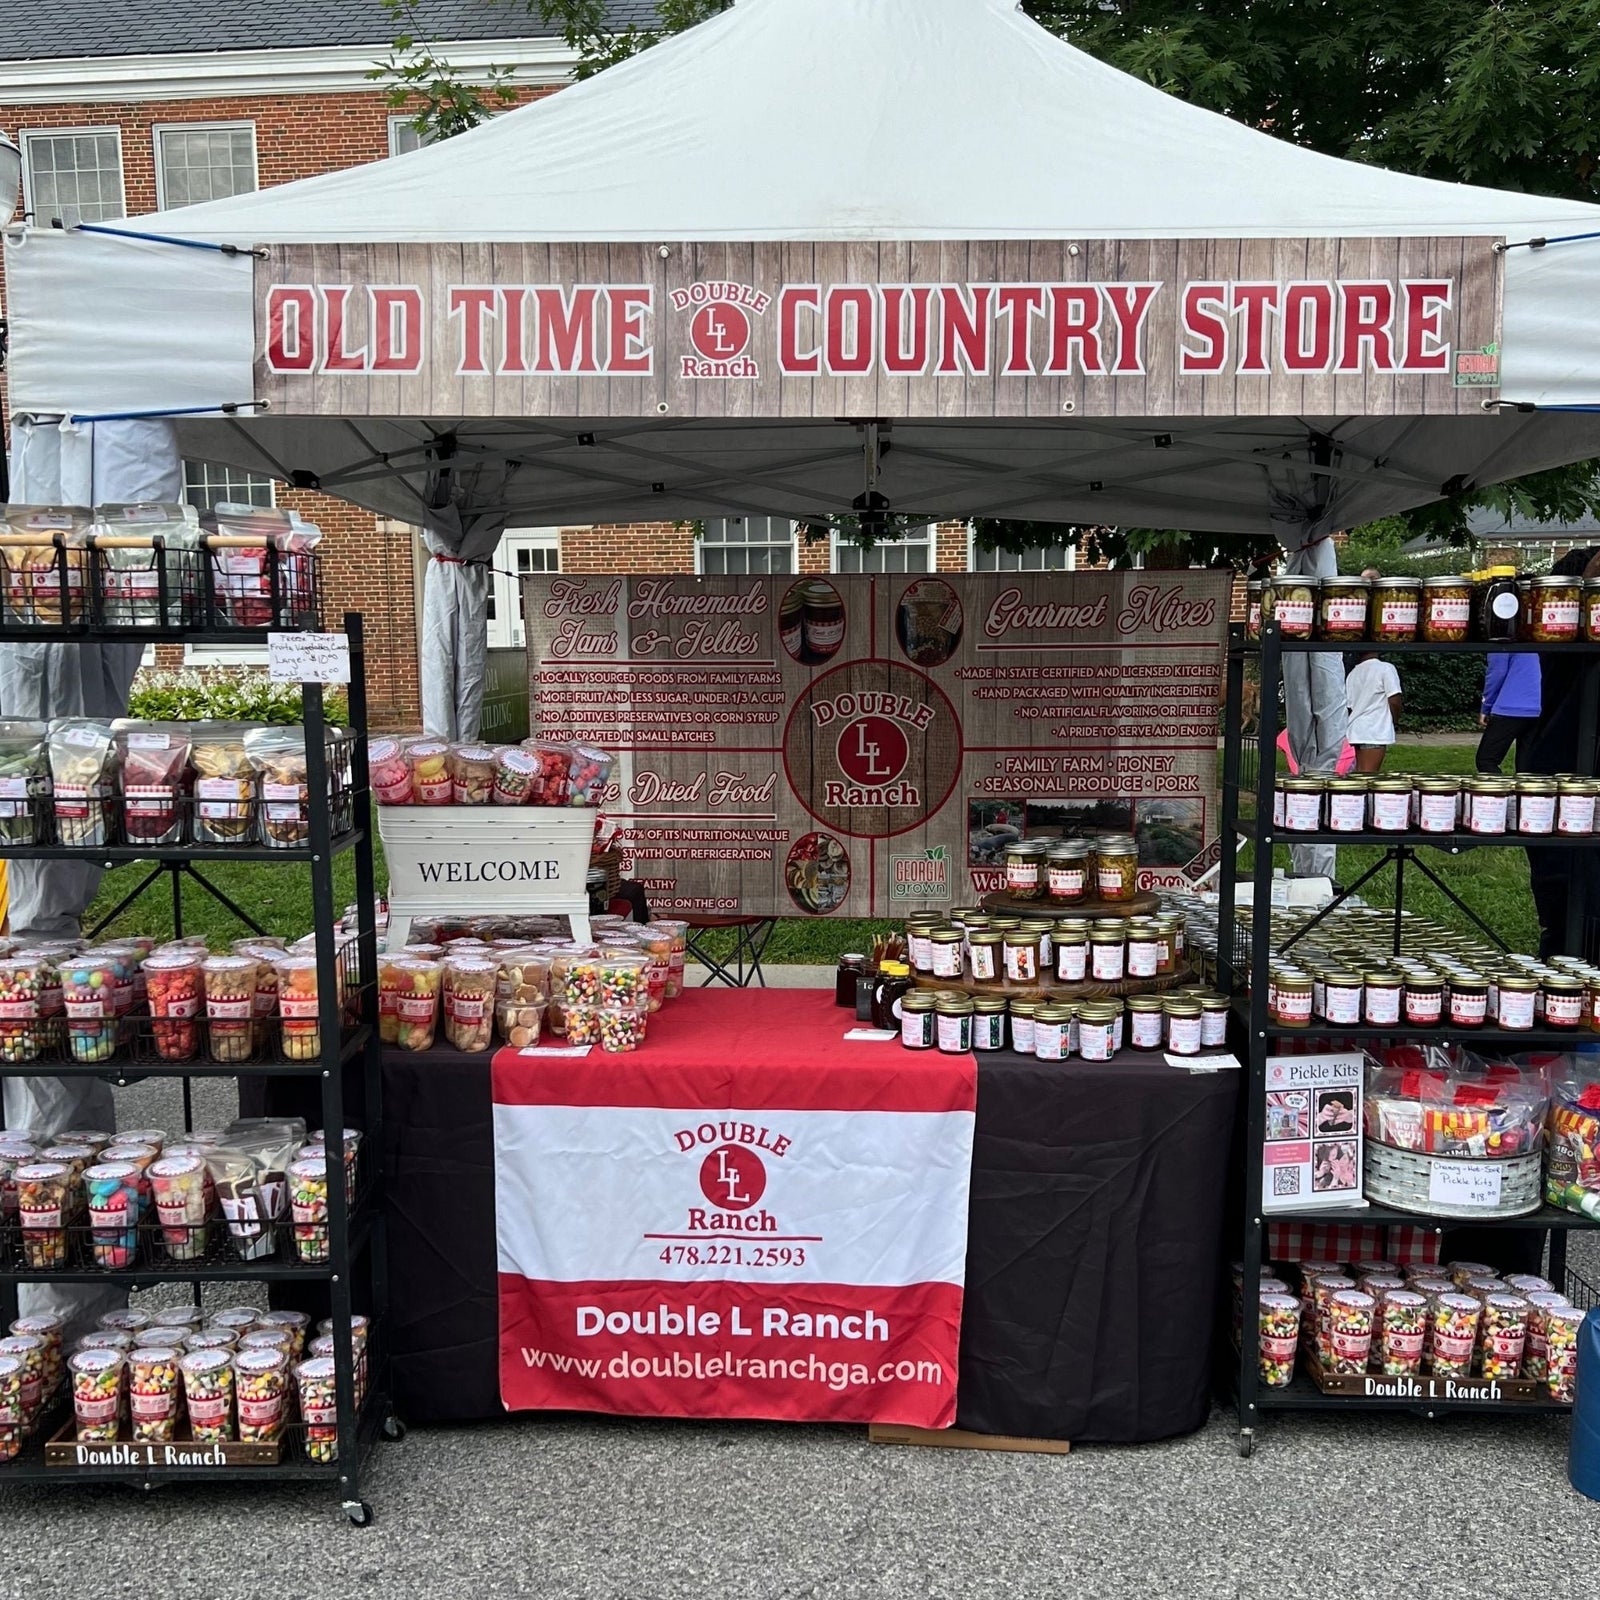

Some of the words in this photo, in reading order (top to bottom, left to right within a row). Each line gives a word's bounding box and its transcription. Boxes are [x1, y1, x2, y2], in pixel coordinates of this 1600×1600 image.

[669, 280, 771, 315] DOUBLE
[265, 283, 425, 375] OLD
[447, 284, 654, 376] TIME
[777, 281, 1164, 376] COUNTRY
[1180, 279, 1453, 375] STORE
[681, 355, 760, 379] Ranch
[544, 579, 623, 618] Fresh
[627, 579, 768, 618] Homemade
[984, 587, 1108, 637] Gourmet
[1116, 585, 1215, 634] Mixes
[552, 620, 618, 658] Jams
[676, 620, 759, 659] Jellies
[540, 672, 587, 683] LOCALLY
[588, 672, 637, 683] SOURCED
[638, 672, 675, 683] FOODS
[677, 673, 708, 684] FROM
[710, 673, 745, 684] FAMILY
[748, 673, 782, 684] FARMS
[961, 667, 992, 679] MADE
[995, 667, 1007, 679] IN
[1009, 666, 1039, 678] STATE
[1041, 666, 1094, 678] CERTIFIED
[1096, 666, 1120, 678] AND
[1122, 665, 1172, 677] LICENSED
[1174, 665, 1220, 677] KITCHEN
[541, 692, 573, 703] MORE
[574, 692, 604, 703] FRUIT
[604, 692, 628, 703] AND
[630, 692, 652, 703] LESS
[655, 692, 692, 704] SUGAR,
[693, 693, 729, 704] UNDER
[732, 693, 750, 704] 1/3
[751, 693, 760, 704] A
[761, 693, 785, 704] CUP!
[980, 686, 1010, 699] HAND
[1013, 686, 1068, 698] PACKAGED
[1071, 685, 1100, 698] WITH
[1102, 684, 1149, 698] QUALITY
[1151, 684, 1219, 697] INGREDIENTS
[481, 701, 512, 731] UILDING
[542, 711, 560, 723] NO
[561, 711, 615, 723] ADDITIVES
[617, 711, 694, 723] PRESERVATIVES
[695, 711, 712, 723] OR
[713, 711, 744, 723] CORN
[745, 711, 779, 723] SYRUP
[810, 691, 935, 730] DOUBLE
[1020, 706, 1039, 718] NO
[1041, 706, 1097, 718] ARTIFICIAL
[1099, 706, 1159, 718] FLAVORING
[1160, 705, 1177, 717] OR
[1179, 705, 1218, 717] FILLERS
[542, 730, 573, 742] HAND
[574, 730, 621, 742] CRAFTED
[623, 730, 634, 742] IN
[636, 730, 670, 742] SMALL
[671, 730, 715, 742] BATCHES
[1058, 726, 1067, 737] A
[1069, 726, 1100, 737] PRIDE
[1101, 726, 1117, 737] TO
[1119, 725, 1154, 736] SERVE
[1154, 725, 1179, 736] AND
[1005, 757, 1058, 772] FAMILY
[1062, 757, 1104, 772] FARM
[1117, 756, 1175, 771] HONEY
[628, 771, 707, 806] Dried
[708, 771, 778, 806] Food
[825, 780, 920, 807] Ranch
[984, 777, 1065, 792] SEASONAL
[1068, 776, 1143, 791] PRODUCE
[1154, 775, 1200, 790] PORK
[625, 830, 644, 840] 97%
[647, 830, 662, 840] OF
[665, 830, 680, 840] ITS
[682, 831, 753, 841] NUTRITIONAL
[756, 831, 789, 841] VALUE
[665, 848, 688, 860] OUT
[690, 849, 772, 860] REFRIGERATION
[417, 860, 560, 883] WELCOME
[895, 861, 946, 882] GEORGIA
[634, 879, 676, 889] ALTHY
[895, 883, 946, 896] grown
[646, 899, 672, 908] KING
[675, 899, 694, 908] ON
[694, 899, 714, 909] THE
[717, 899, 738, 909] GO!
[1290, 1065, 1329, 1080] Pickle
[1333, 1063, 1359, 1077] Kits
[674, 1121, 793, 1158] DOUBLE
[688, 1208, 778, 1231] Ranch
[659, 1245, 806, 1267] 478.221.2593
[575, 1304, 721, 1337] Double
[731, 1306, 753, 1337] L
[762, 1308, 890, 1342] Ranch
[520, 1346, 943, 1390] www.doublelranchga.com
[1364, 1378, 1423, 1398] Double
[1429, 1380, 1439, 1397] L
[1445, 1380, 1501, 1400] Ranch
[76, 1445, 140, 1465] Double
[147, 1446, 157, 1465] L
[165, 1444, 226, 1465] Ranch
